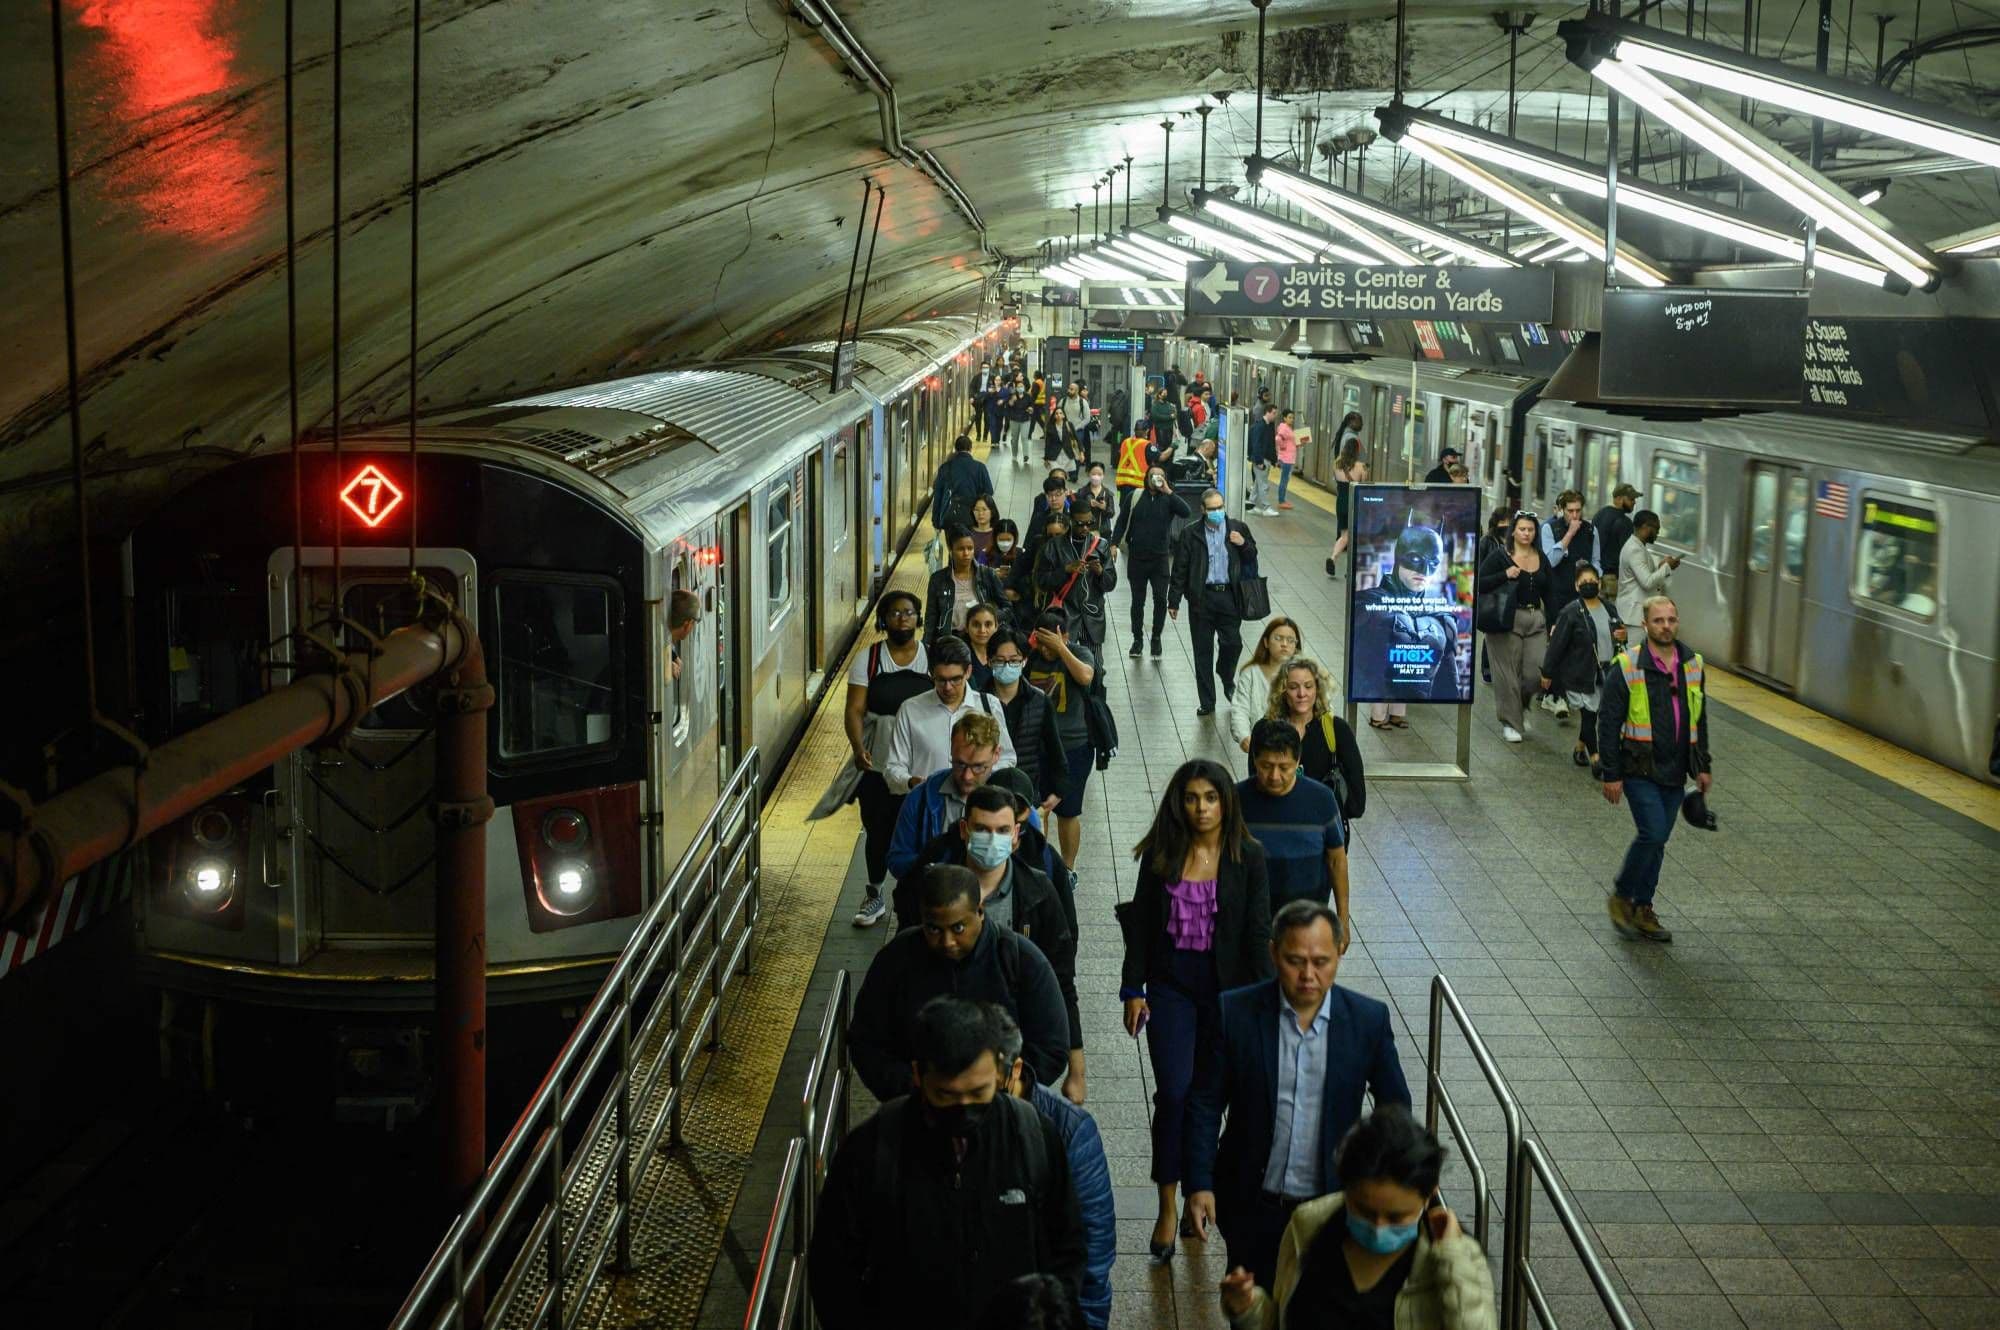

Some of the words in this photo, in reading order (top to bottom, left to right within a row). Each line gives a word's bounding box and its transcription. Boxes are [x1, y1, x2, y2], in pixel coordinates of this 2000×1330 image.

[1255, 275, 1269, 296] 7
[1283, 266, 1346, 286] Javits
[1354, 267, 1427, 288] Center
[1435, 270, 1451, 289] &
[1282, 288, 1311, 307] 34
[1320, 289, 1436, 311] St-Hudson
[1445, 291, 1503, 312] Yards
[1813, 320, 1848, 343] Square
[1833, 364, 1863, 385] Yards
[1820, 384, 1848, 405] times
[360, 478, 382, 514] 7
[1365, 603, 1387, 611] when
[1388, 604, 1403, 613] you
[1404, 604, 1424, 612] need
[1381, 596, 1395, 604] the
[1412, 596, 1421, 604] to
[1390, 649, 1434, 662] max
